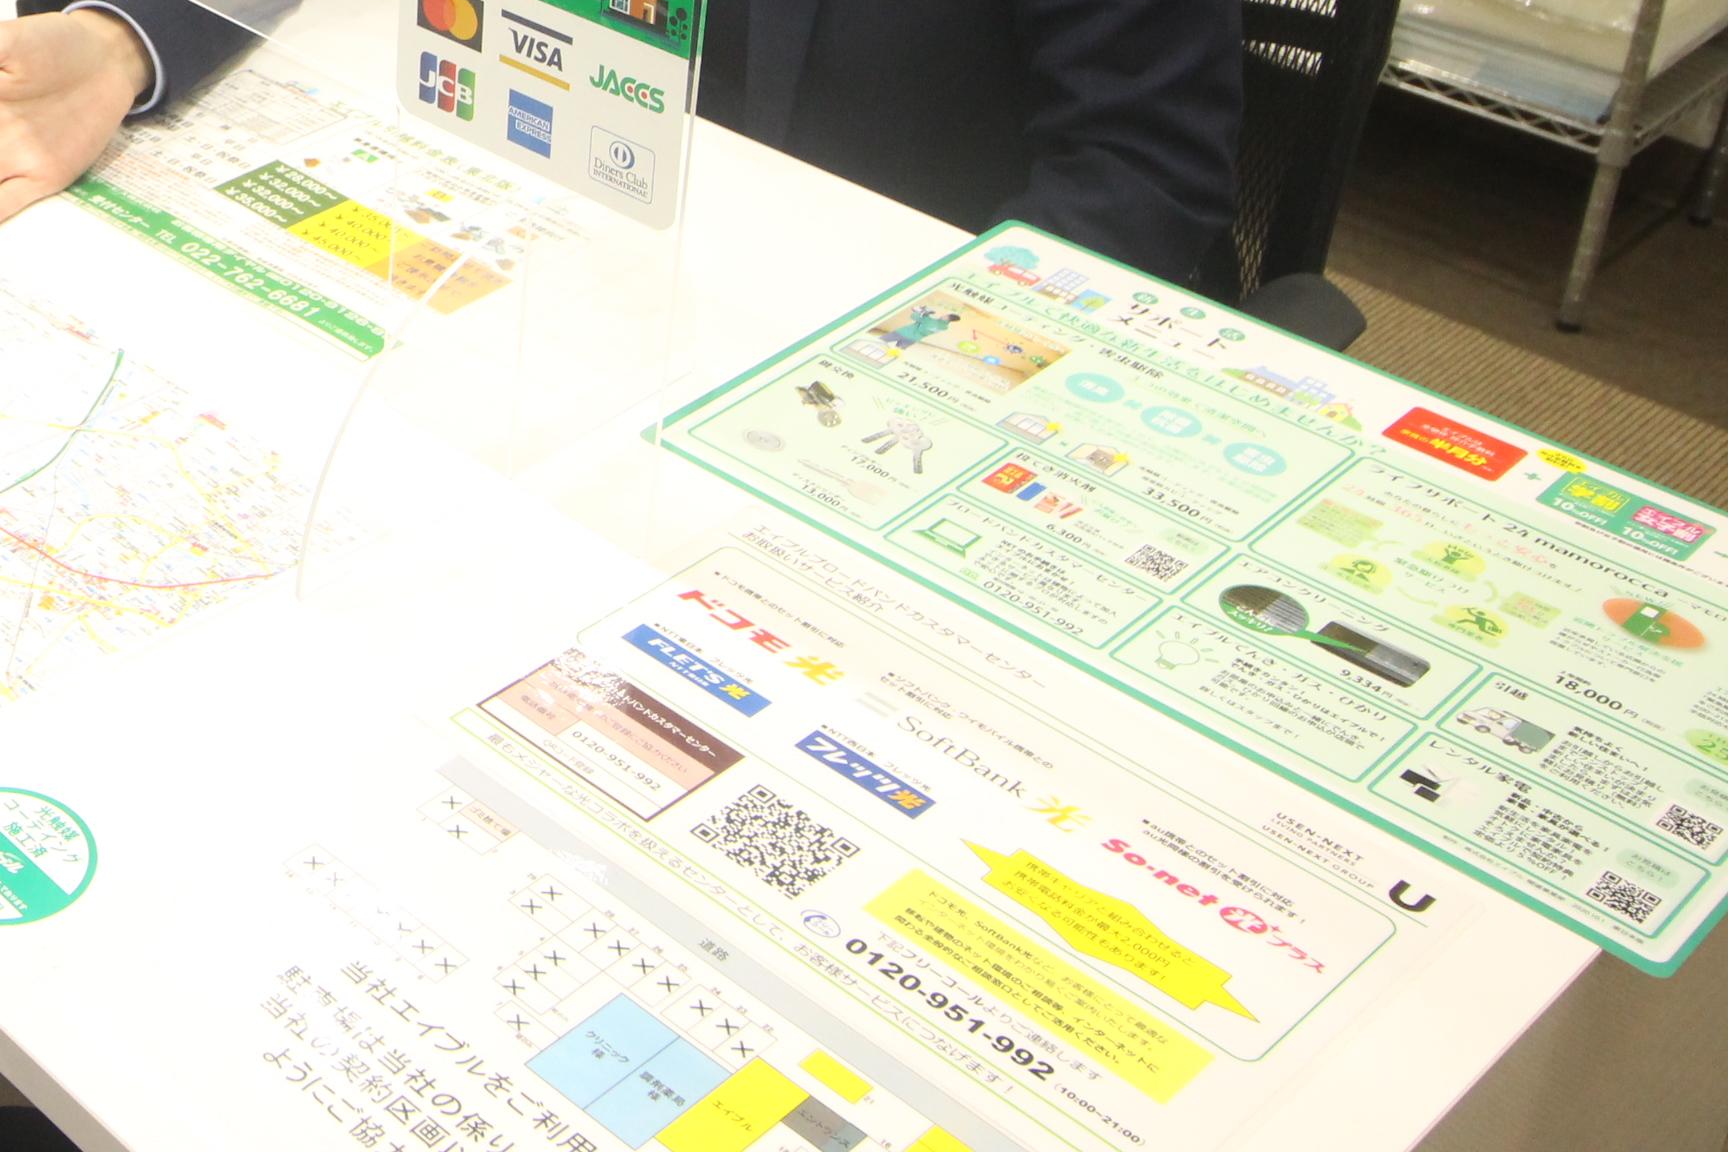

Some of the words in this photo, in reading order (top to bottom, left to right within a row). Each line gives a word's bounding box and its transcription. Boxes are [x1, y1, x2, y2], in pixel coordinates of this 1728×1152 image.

[507, 27, 563, 71] VISA
[419, 65, 473, 106] JCB
[589, 60, 665, 115] JACCS
[515, 120, 551, 143] EXPRESS
[593, 168, 647, 198] INTERNATIONAL
[594, 156, 621, 177] Diners
[625, 170, 648, 190] Club
[152, 230, 179, 244] TEL
[177, 240, 322, 320] 022-762-6681
[946, 282, 1167, 379] 光触媒コーティング・害虫駆除
[1366, 464, 1500, 525] ライフサポート
[1532, 536, 1671, 600] mamorocca
[1631, 511, 1698, 543] 女子割
[740, 530, 885, 613] お取扱いサービス紹介
[751, 523, 1049, 690] エイブルブロードバンドカスタマーセンター
[1236, 557, 1392, 635] エアコンクリーニング
[674, 586, 794, 655] ドコモ
[781, 647, 849, 689] 光
[980, 579, 1085, 636] 0120-951-992
[644, 636, 727, 685] FLET'S
[718, 680, 752, 701] 光
[1171, 610, 1390, 724] エイブルでんき・ガス・ひかり
[569, 729, 663, 792] 0120-951-992
[801, 735, 928, 812] フレッツ光
[891, 713, 1035, 799] SoftBank
[1023, 789, 1098, 837] 光
[1427, 737, 1534, 796] レンタル家電
[1098, 834, 1223, 909] So-net
[1264, 933, 1331, 975] プラス
[695, 936, 731, 963] 道路
[841, 935, 1058, 1083] 0120-951-992
